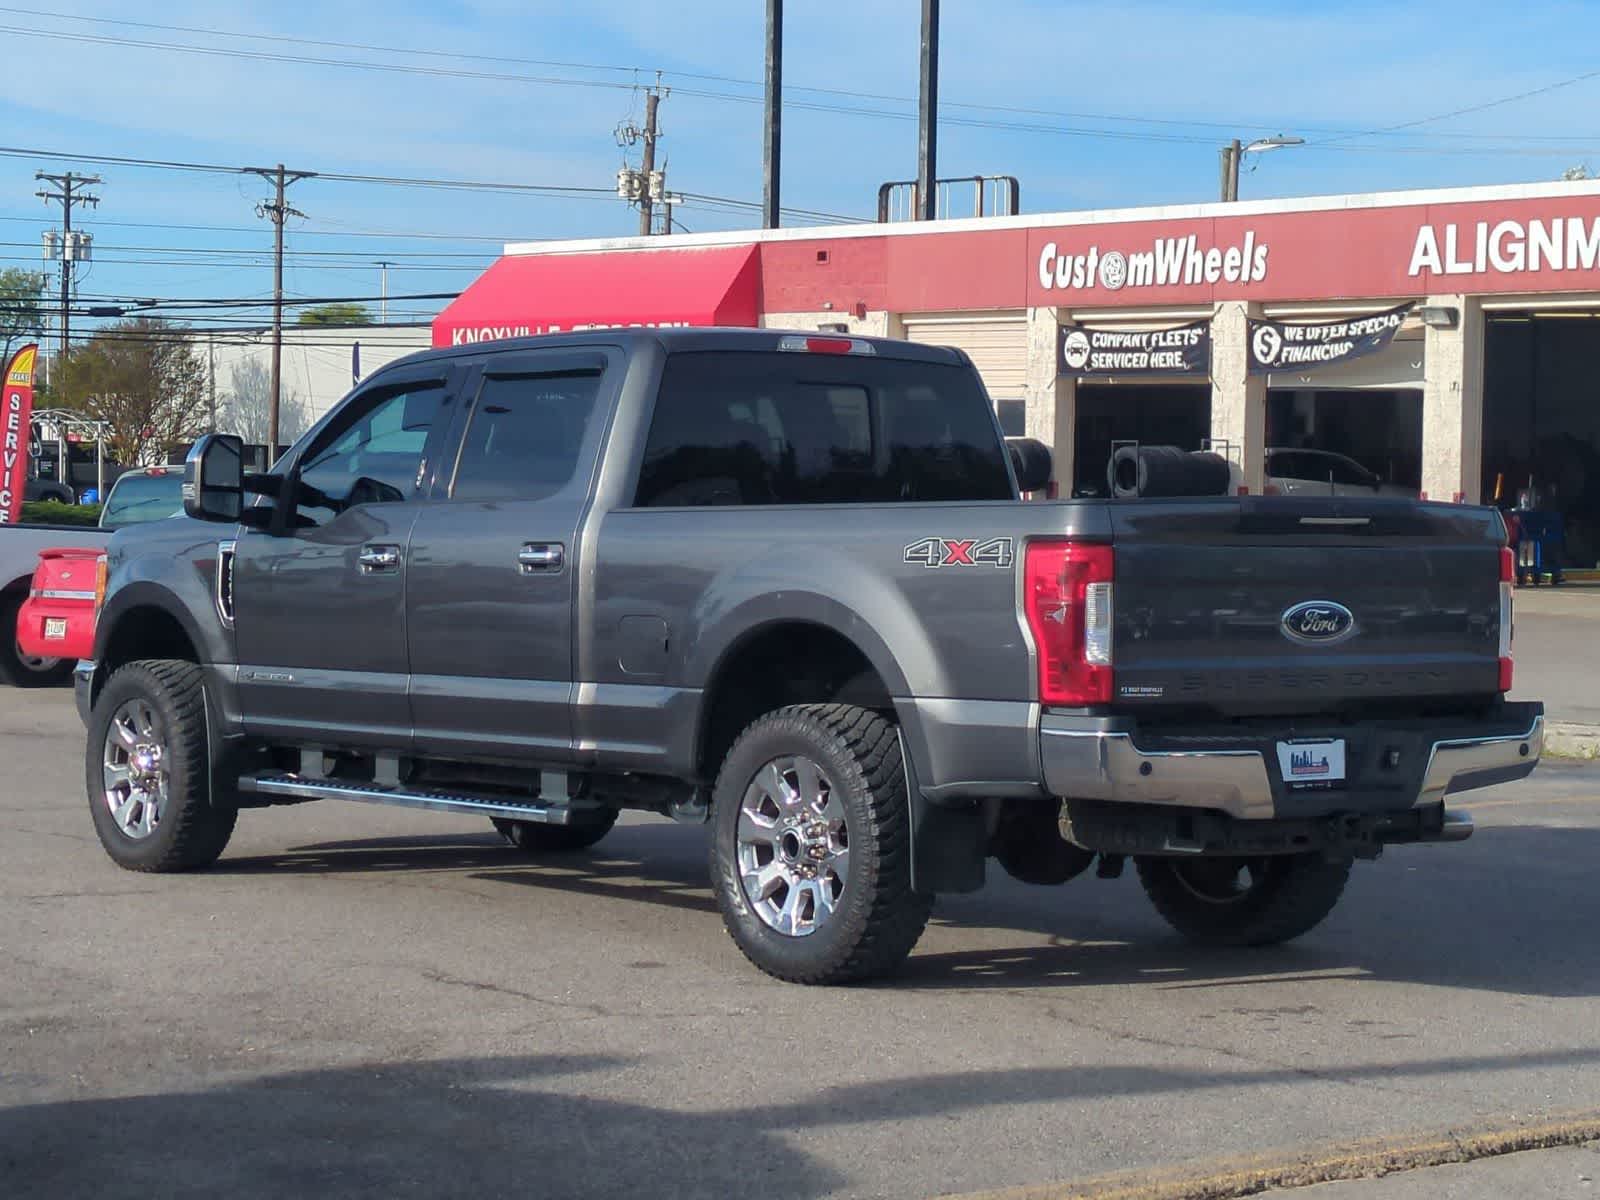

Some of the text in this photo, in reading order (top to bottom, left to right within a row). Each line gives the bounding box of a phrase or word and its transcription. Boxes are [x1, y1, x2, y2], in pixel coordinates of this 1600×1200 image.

[1408, 216, 1600, 276] ALIGNM
[1092, 332, 1150, 348] COMPANY
[1285, 326, 1304, 341] WE
[1348, 313, 1401, 336] SPECIA
[1091, 352, 1149, 368] SERVICED
[0, 394, 20, 523] SERVICE
[1301, 608, 1338, 632] Ford
